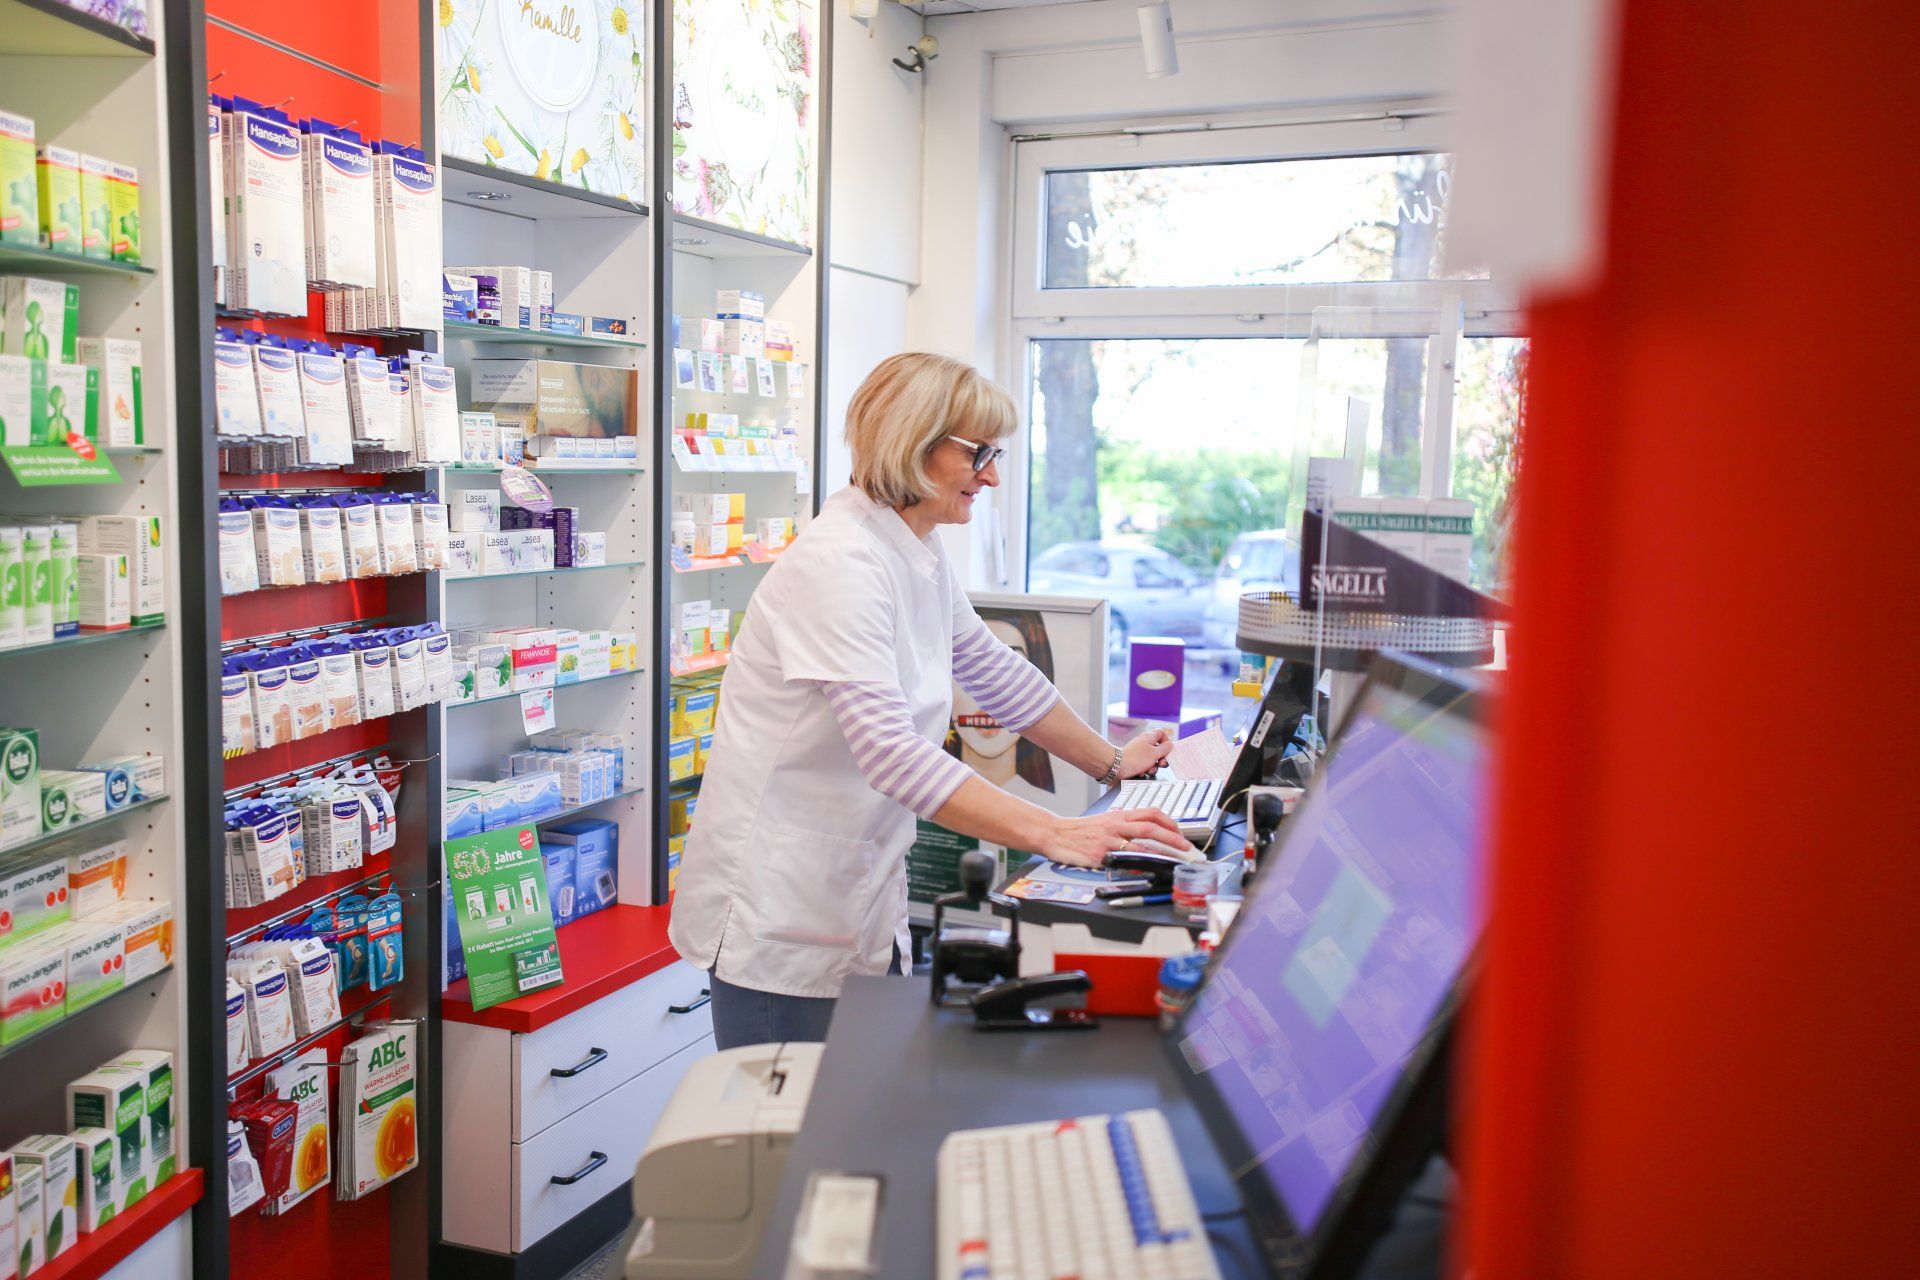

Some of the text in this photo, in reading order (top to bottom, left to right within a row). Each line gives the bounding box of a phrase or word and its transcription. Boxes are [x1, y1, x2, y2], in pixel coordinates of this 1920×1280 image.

[250, 123, 298, 151] Hansaplast
[326, 144, 370, 168] Hansaplast
[395, 163, 433, 184] Hansaplast
[465, 494, 486, 503] Lasea
[487, 537, 509, 546] Lasea
[1311, 572, 1387, 596] SAGELLA
[520, 648, 550, 660] FEMANNOSE
[334, 803, 359, 813] Hansaplast
[258, 821, 285, 838] Hansaplast
[81, 849, 116, 870] Dorithricin
[453, 847, 491, 880] 50
[494, 850, 523, 865] Jahre
[127, 914, 161, 936] Dorithricin
[476, 941, 494, 951] Rabatt
[303, 957, 330, 973] Hansaplast
[257, 978, 286, 994] Hansaplast
[368, 1034, 407, 1073] ABC
[364, 1063, 410, 1090] WÄRME-PFLASTER
[289, 1075, 319, 1102] ABC
[274, 1117, 293, 1136] durex
